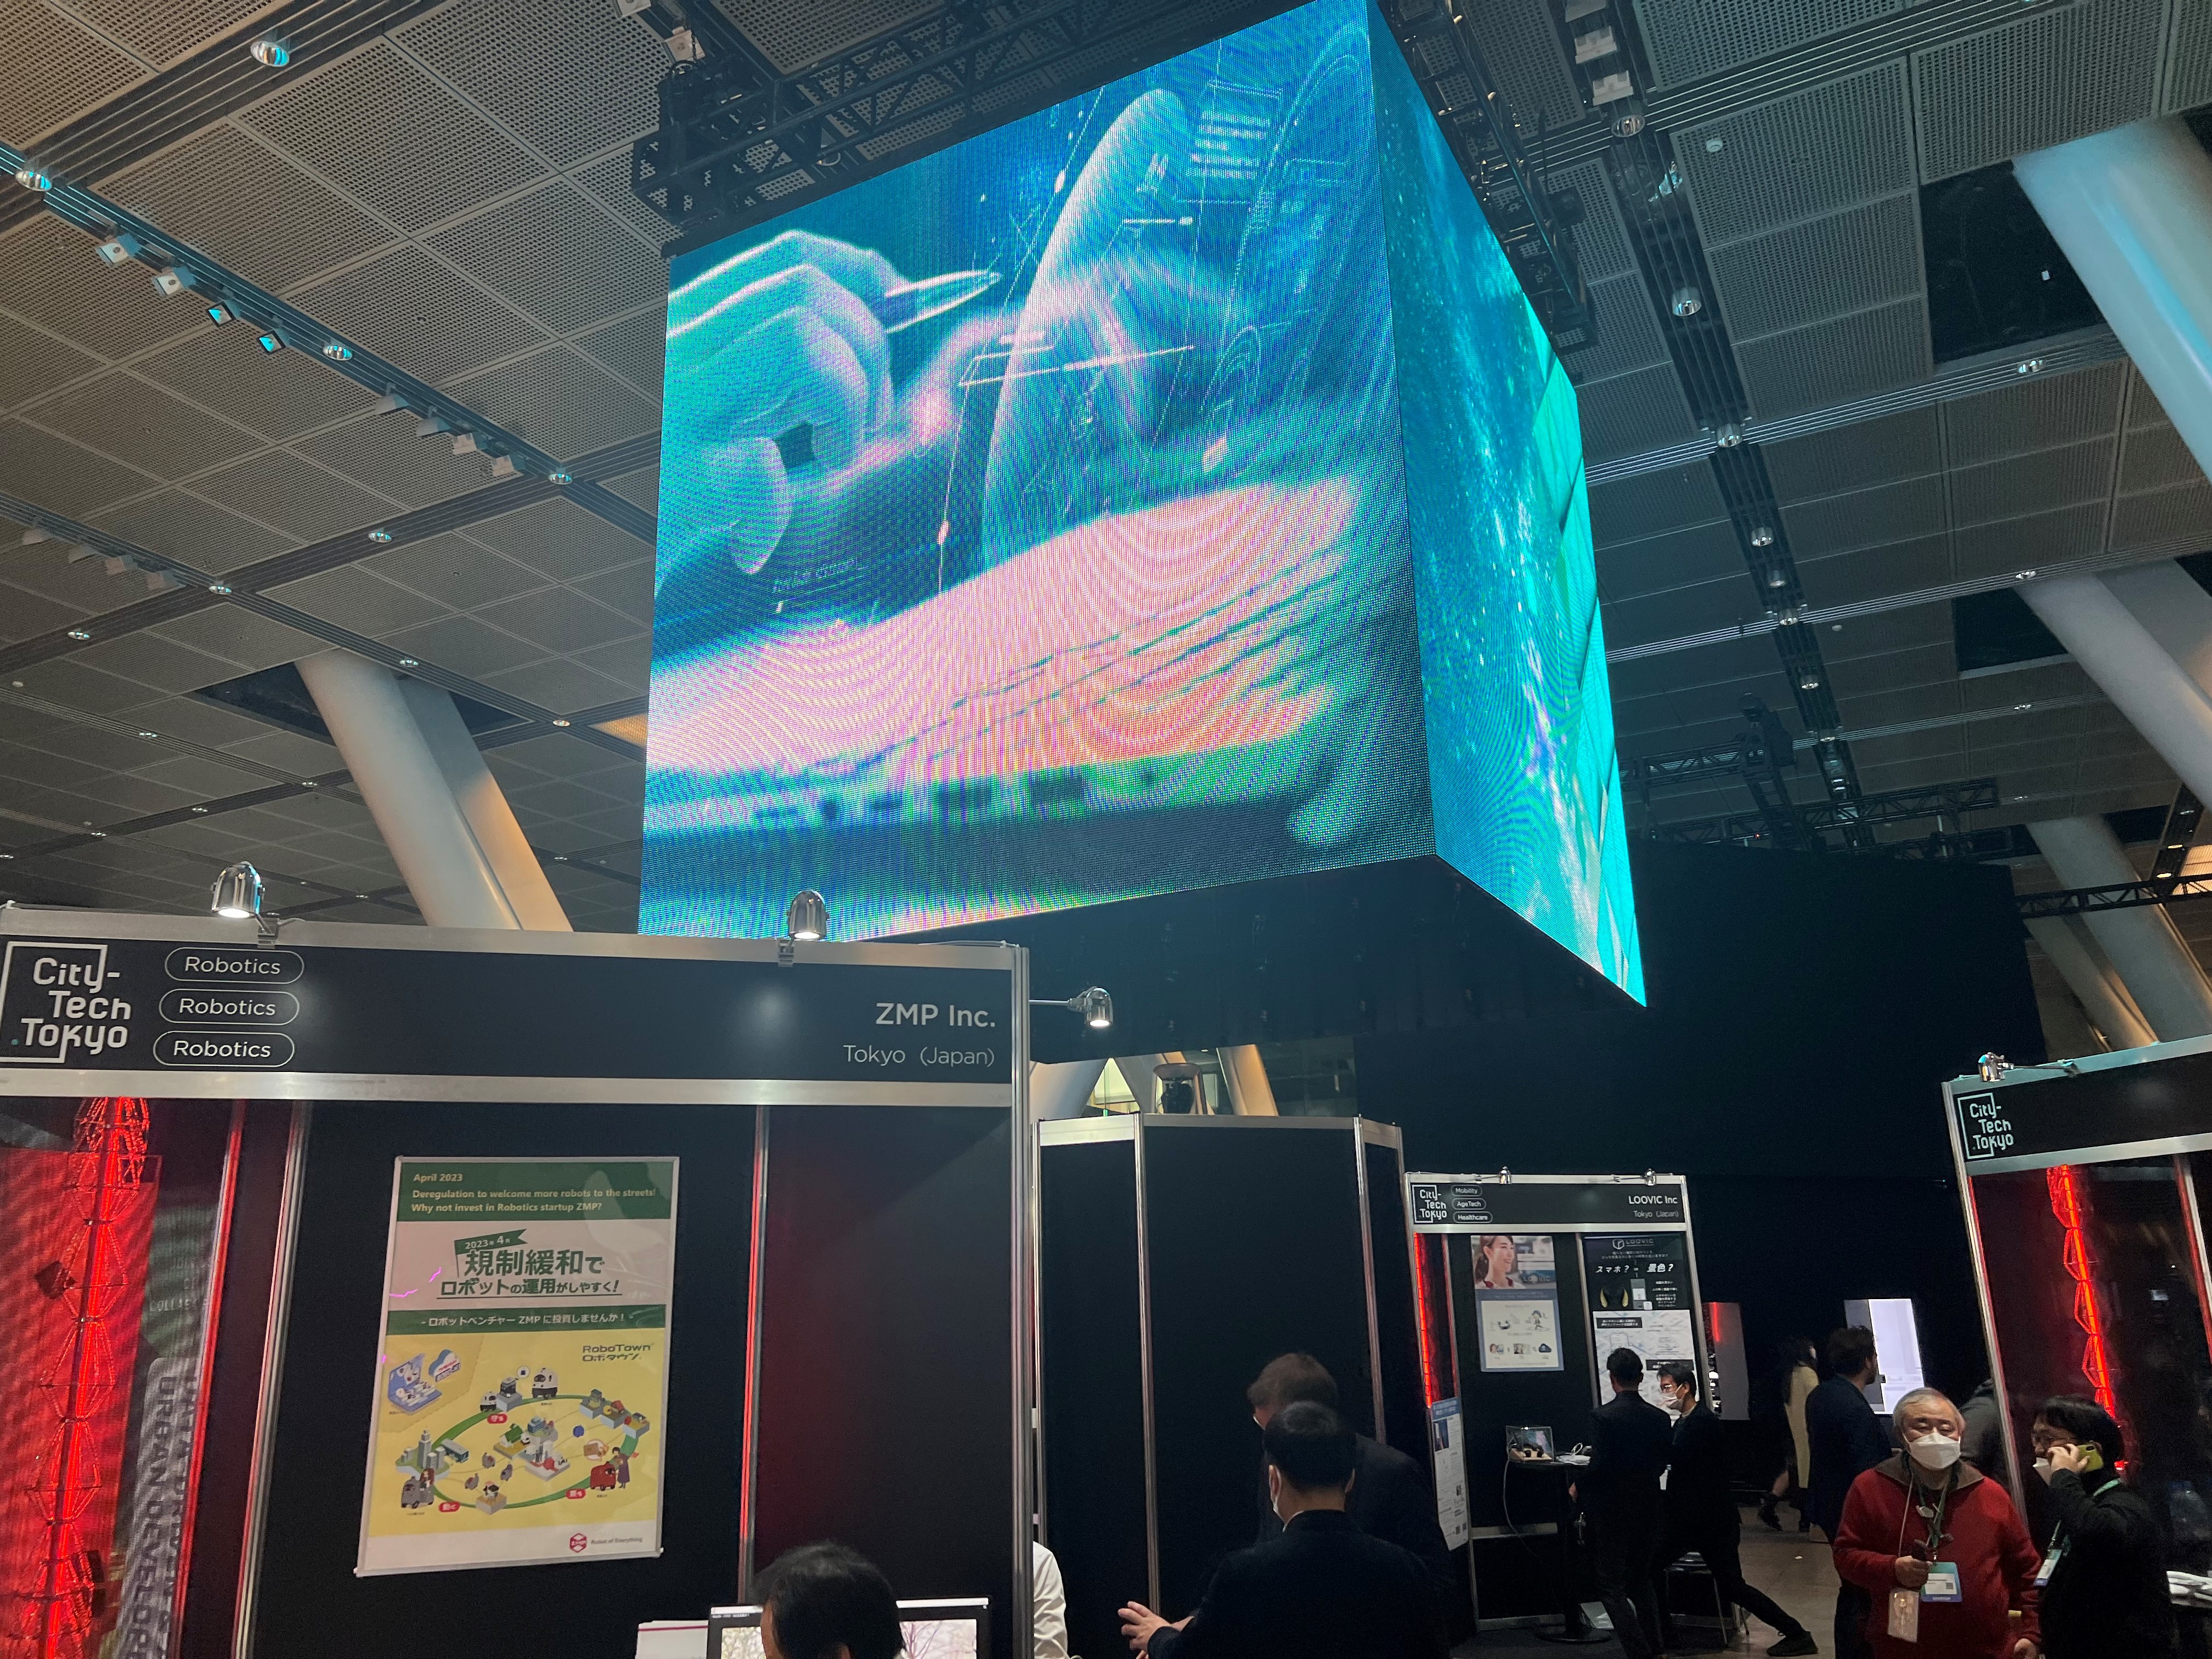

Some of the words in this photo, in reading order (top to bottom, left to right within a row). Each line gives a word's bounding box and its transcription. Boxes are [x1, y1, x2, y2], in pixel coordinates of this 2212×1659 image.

[184, 956, 281, 975] Robotics
[33, 957, 120, 994] City-
[48, 990, 131, 1020] Tech
[179, 997, 275, 1017] Robotics
[876, 1002, 939, 1026] ZMP
[950, 1005, 995, 1028] Inc.
[173, 1040, 271, 1059] Robotics
[843, 1045, 905, 1066] Tokyo
[920, 1047, 995, 1068] (Japan)
[1970, 1103, 2001, 1119] City-
[1978, 1119, 2012, 1134] Tech
[414, 1173, 437, 1183] April
[412, 1190, 475, 1200] Deregulation
[490, 1189, 532, 1198] welcome
[1419, 1189, 1441, 1200] City-
[1628, 1195, 1663, 1204] LOOVIC
[1664, 1195, 1678, 1204] Inc
[411, 1204, 433, 1214] Why
[497, 1203, 538, 1211] Robotics
[541, 1203, 573, 1212] startup
[577, 1203, 602, 1211] ZMP?
[1425, 1200, 1446, 1209] Tech
[464, 1249, 605, 1276] 規制緩和で
[518, 1316, 540, 1324] ZMP
[583, 1344, 650, 1353] RoboTown
[149, 1376, 177, 1486] URBAN
